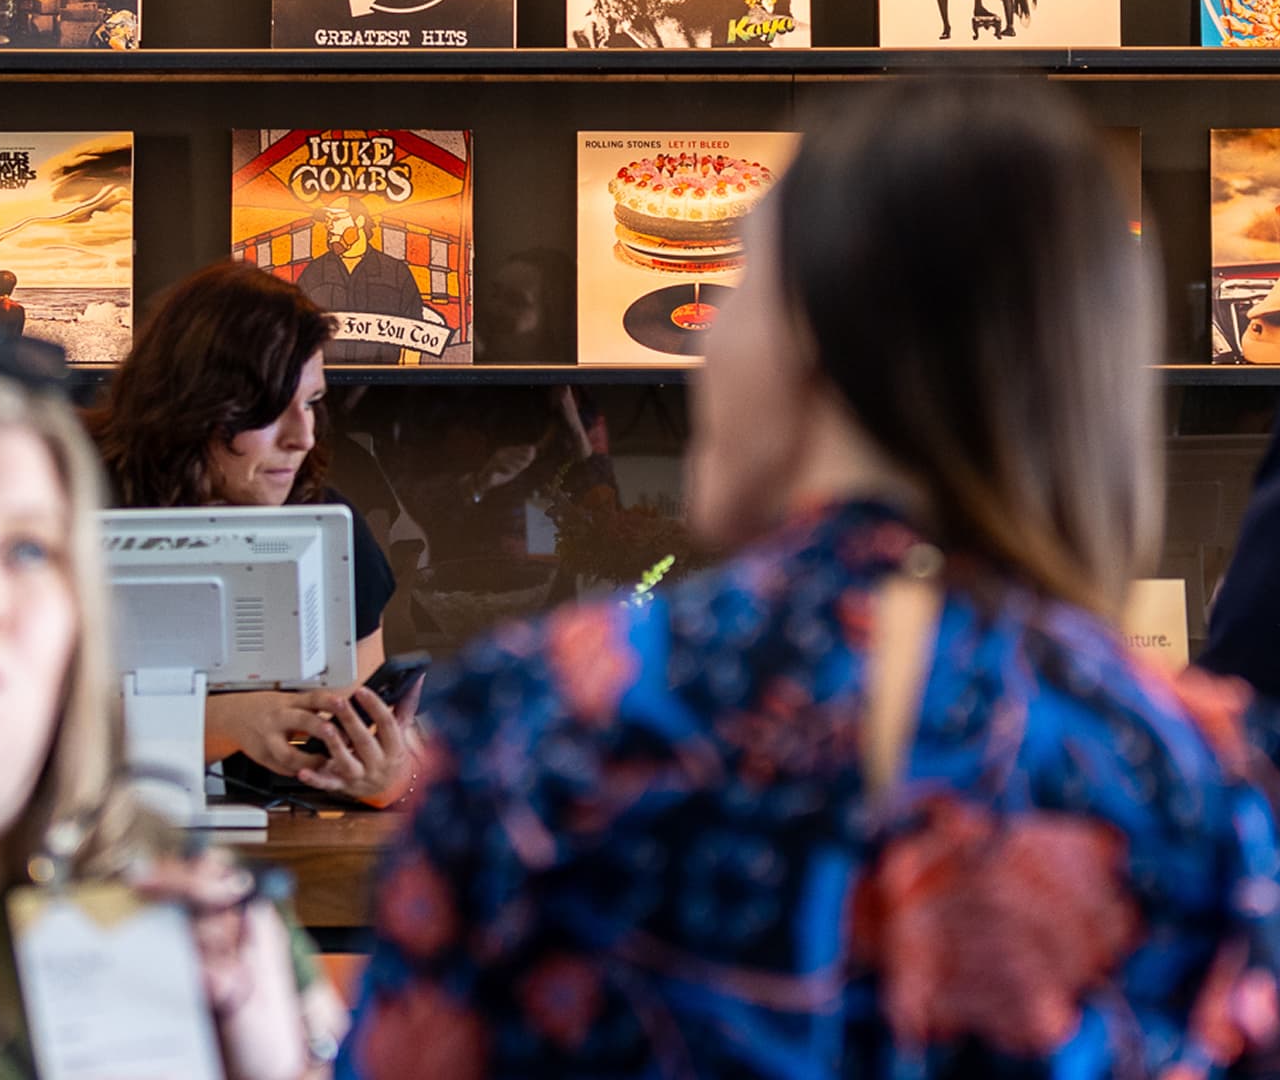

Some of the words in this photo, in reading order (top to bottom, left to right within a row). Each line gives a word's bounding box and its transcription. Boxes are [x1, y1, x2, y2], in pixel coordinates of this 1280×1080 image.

[315, 29, 410, 46] GREATEST
[422, 30, 468, 46] HITS
[308, 136, 394, 166] LUKE
[585, 140, 624, 149] ROLLING
[626, 140, 662, 149] STONES
[668, 140, 685, 149] LET
[687, 140, 698, 149] IT
[700, 140, 730, 149] BLEED
[344, 317, 372, 335] For
[376, 318, 406, 339] You
[409, 324, 440, 348] Too
[1123, 633, 1172, 648] uture.
